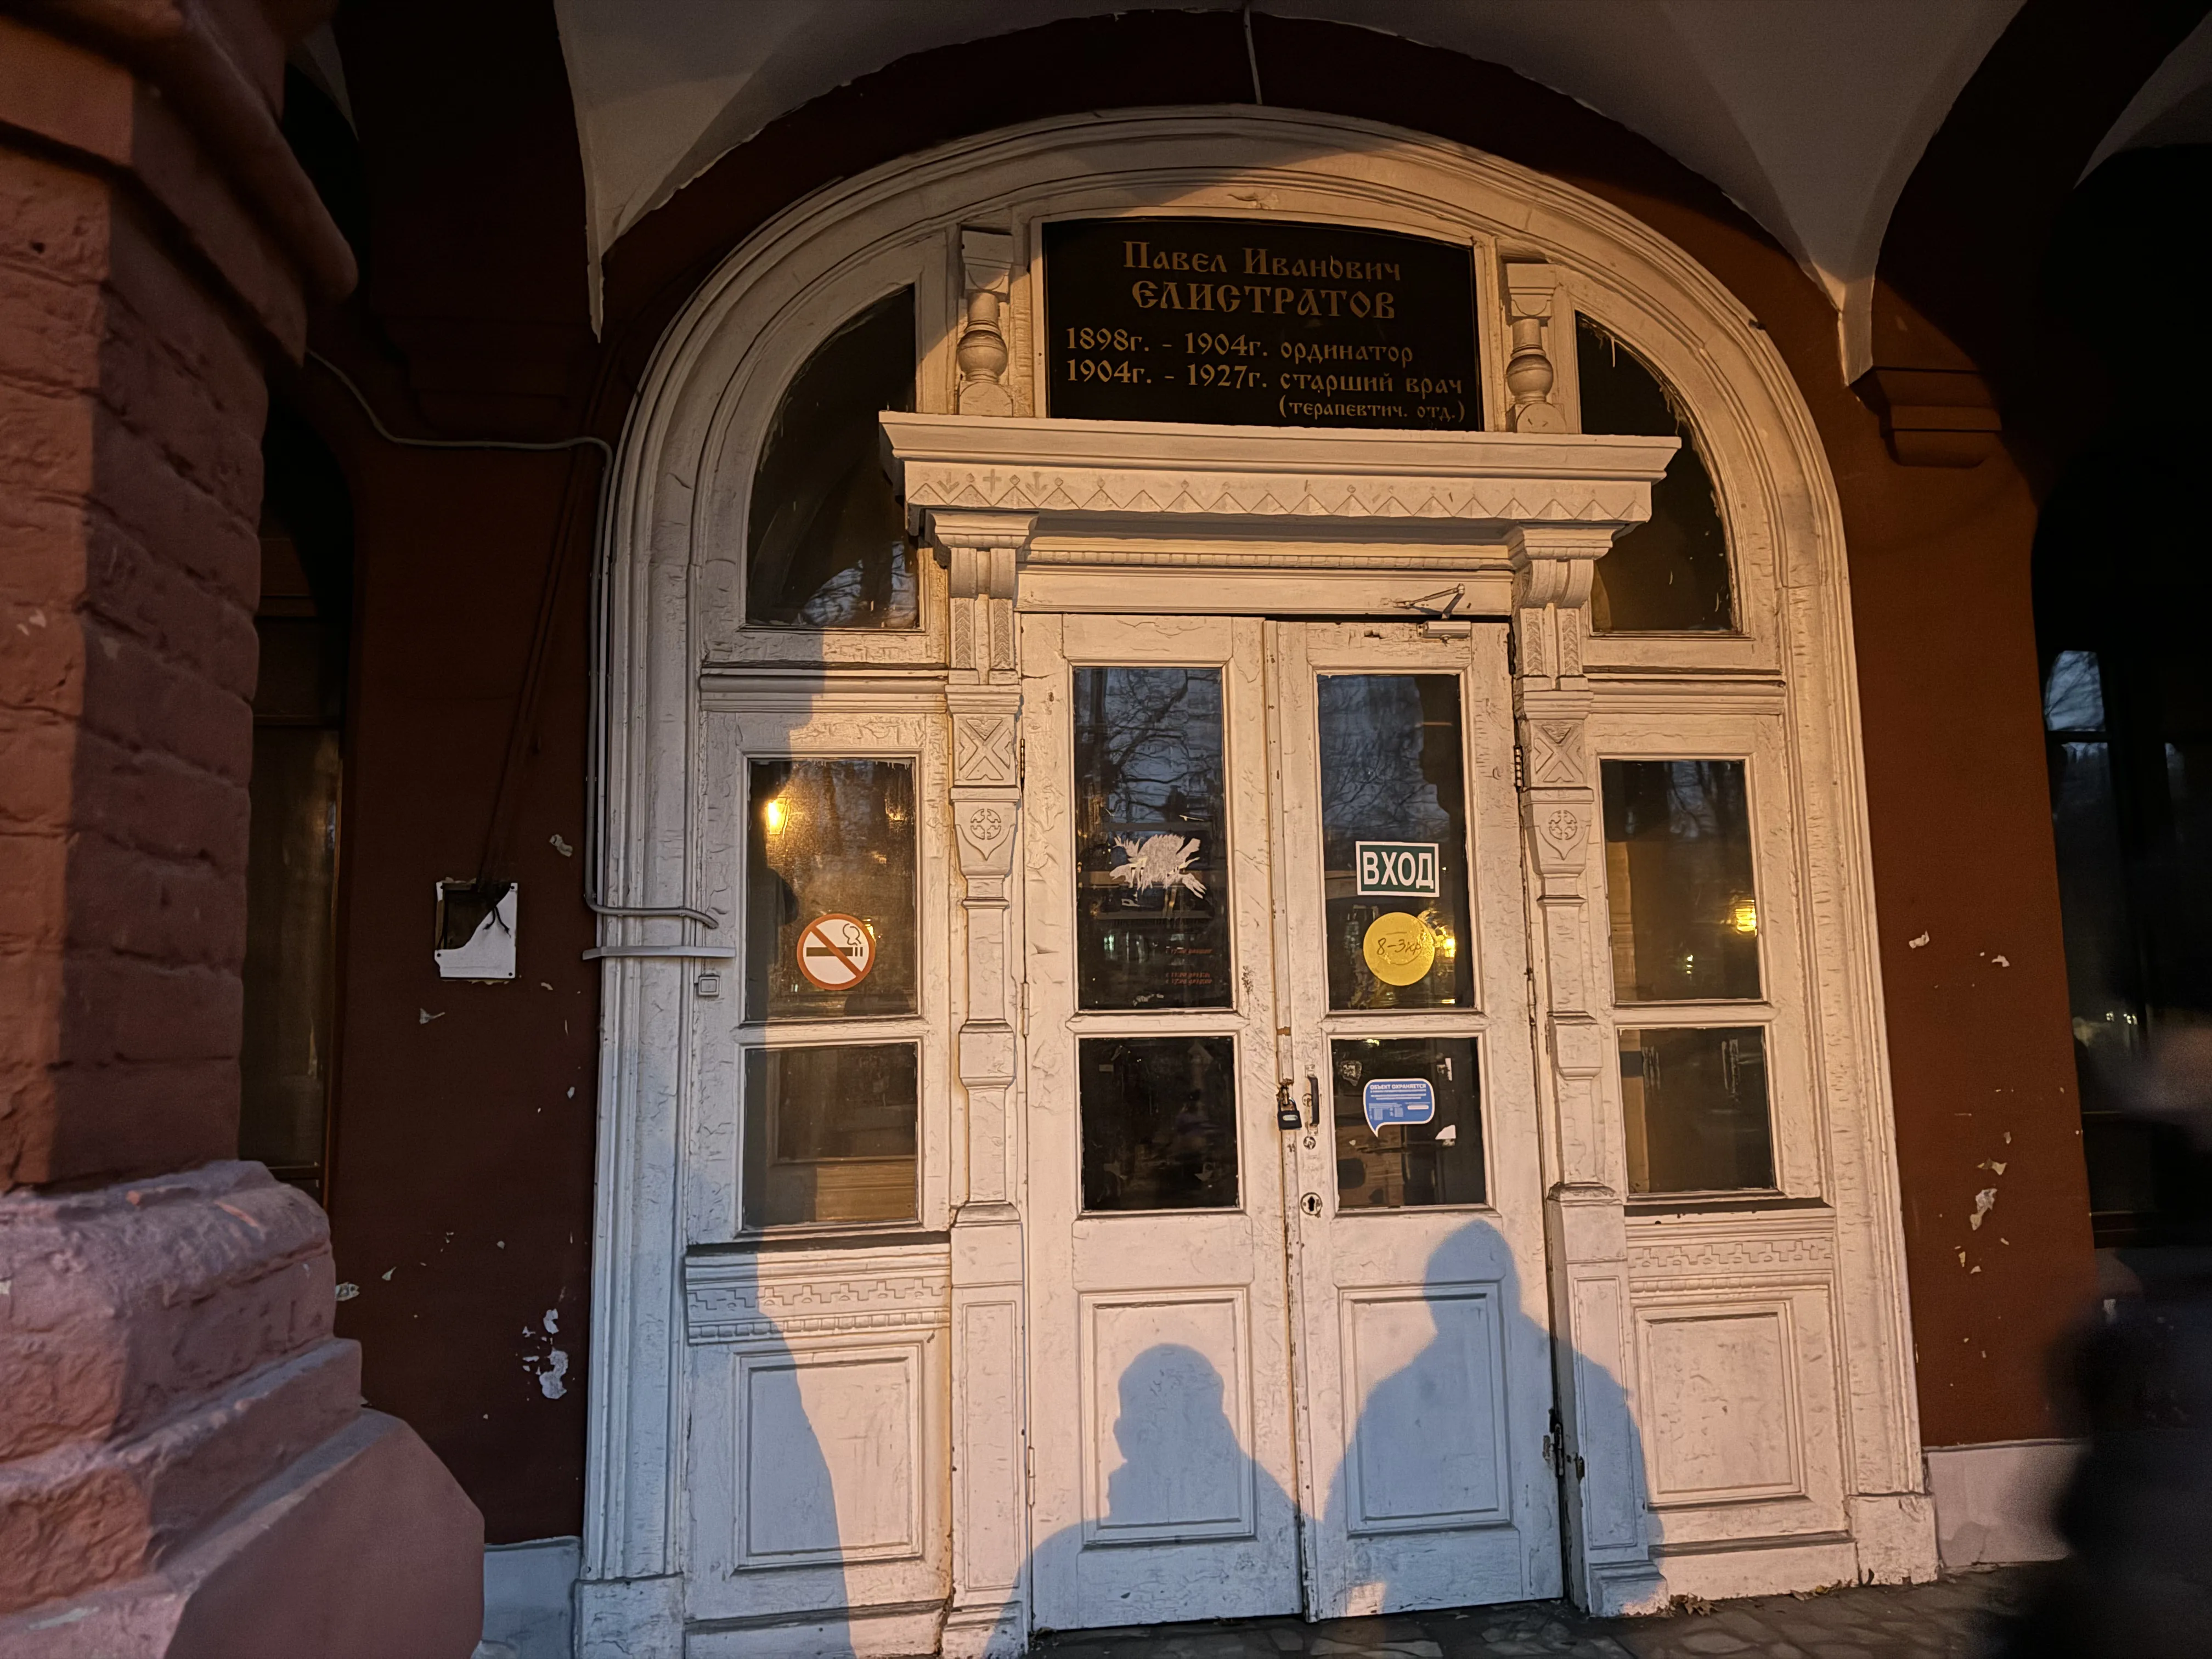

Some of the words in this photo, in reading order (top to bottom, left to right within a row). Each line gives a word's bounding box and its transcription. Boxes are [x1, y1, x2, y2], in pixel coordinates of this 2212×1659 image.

[1123, 241, 1227, 273] Павел
[1242, 247, 1401, 281] Иванович
[1132, 280, 1395, 319] ЕЛИСТРАТОВ
[1066, 327, 1149, 351] 1898г.
[1185, 332, 1268, 357] 1904г.
[1280, 341, 1413, 369] ординатор
[1066, 358, 1152, 383] 1904г.
[1187, 363, 1267, 389] 1927г.
[1279, 372, 1393, 397] старший
[1406, 377, 1462, 400] врач
[1279, 394, 1408, 420] (терапевтич.
[1417, 400, 1465, 422] отд.)
[1362, 851, 1434, 889] ВХОД
